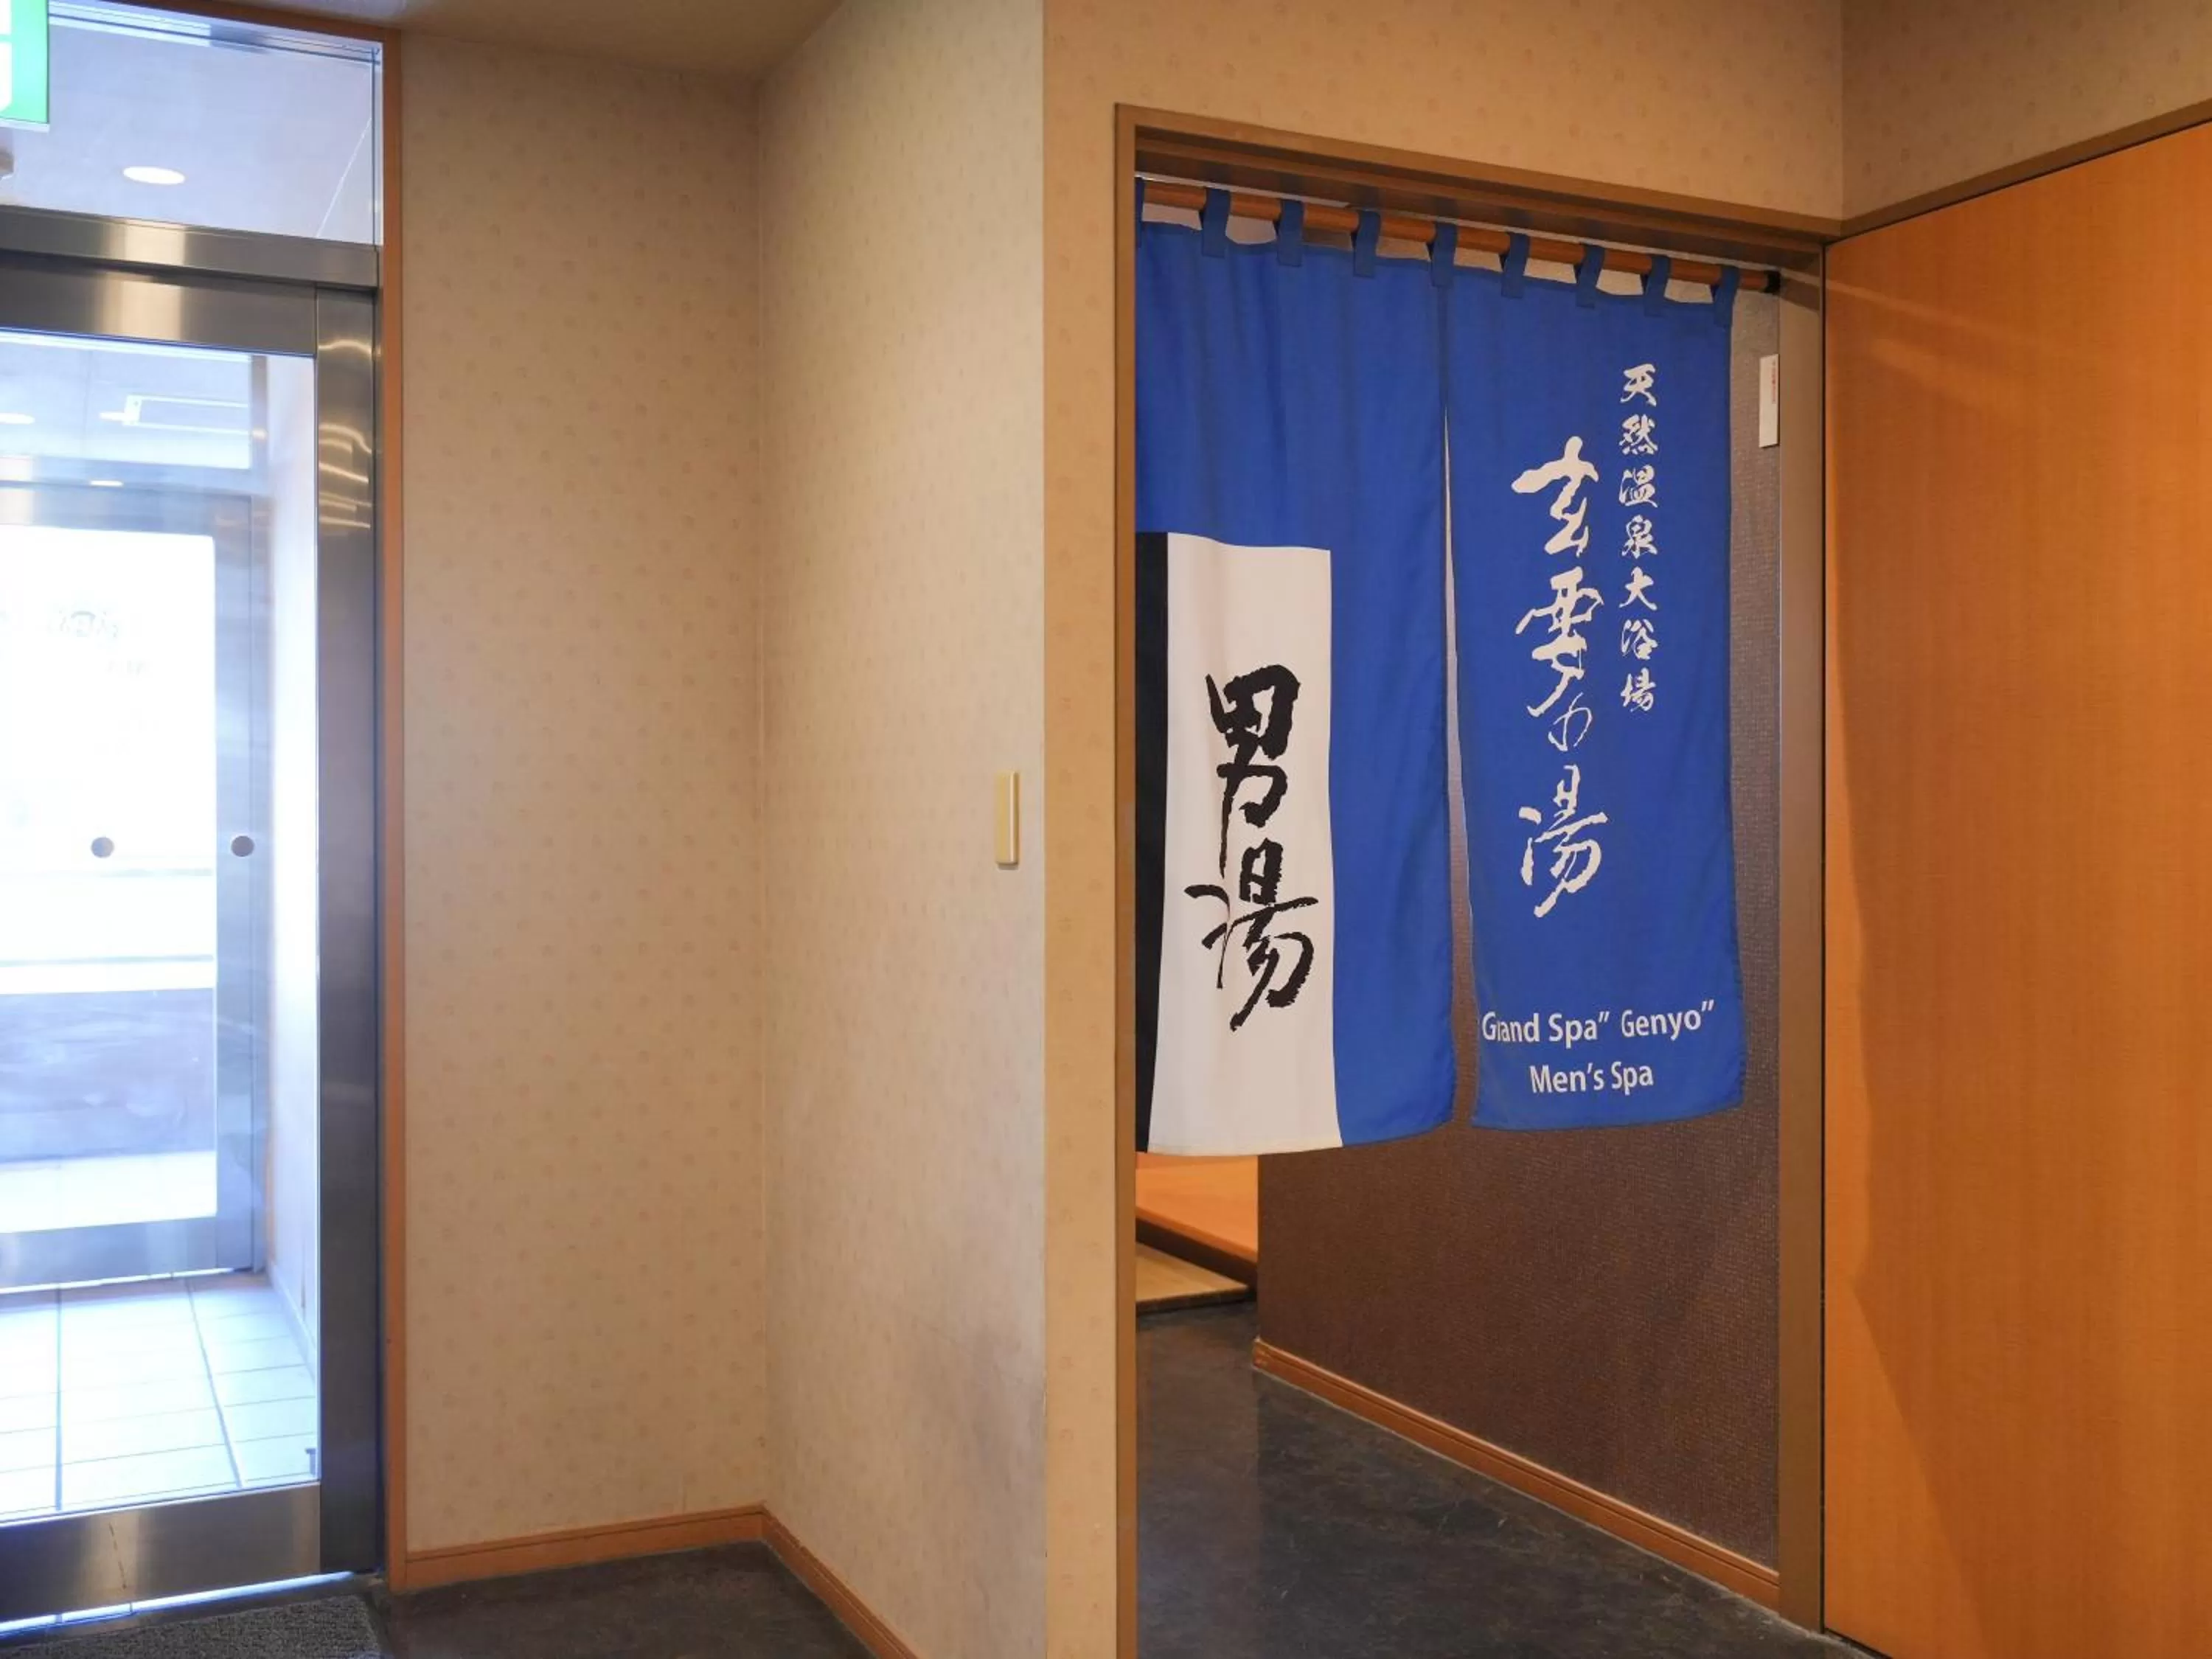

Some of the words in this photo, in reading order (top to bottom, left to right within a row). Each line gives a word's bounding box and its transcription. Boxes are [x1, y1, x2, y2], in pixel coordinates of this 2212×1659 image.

[1618, 363, 1659, 712] 天然温泉大浴場
[1184, 664, 1319, 1032] 男湯
[1529, 1062, 1604, 1093] Men's
[1610, 1061, 1654, 1096] Spa
